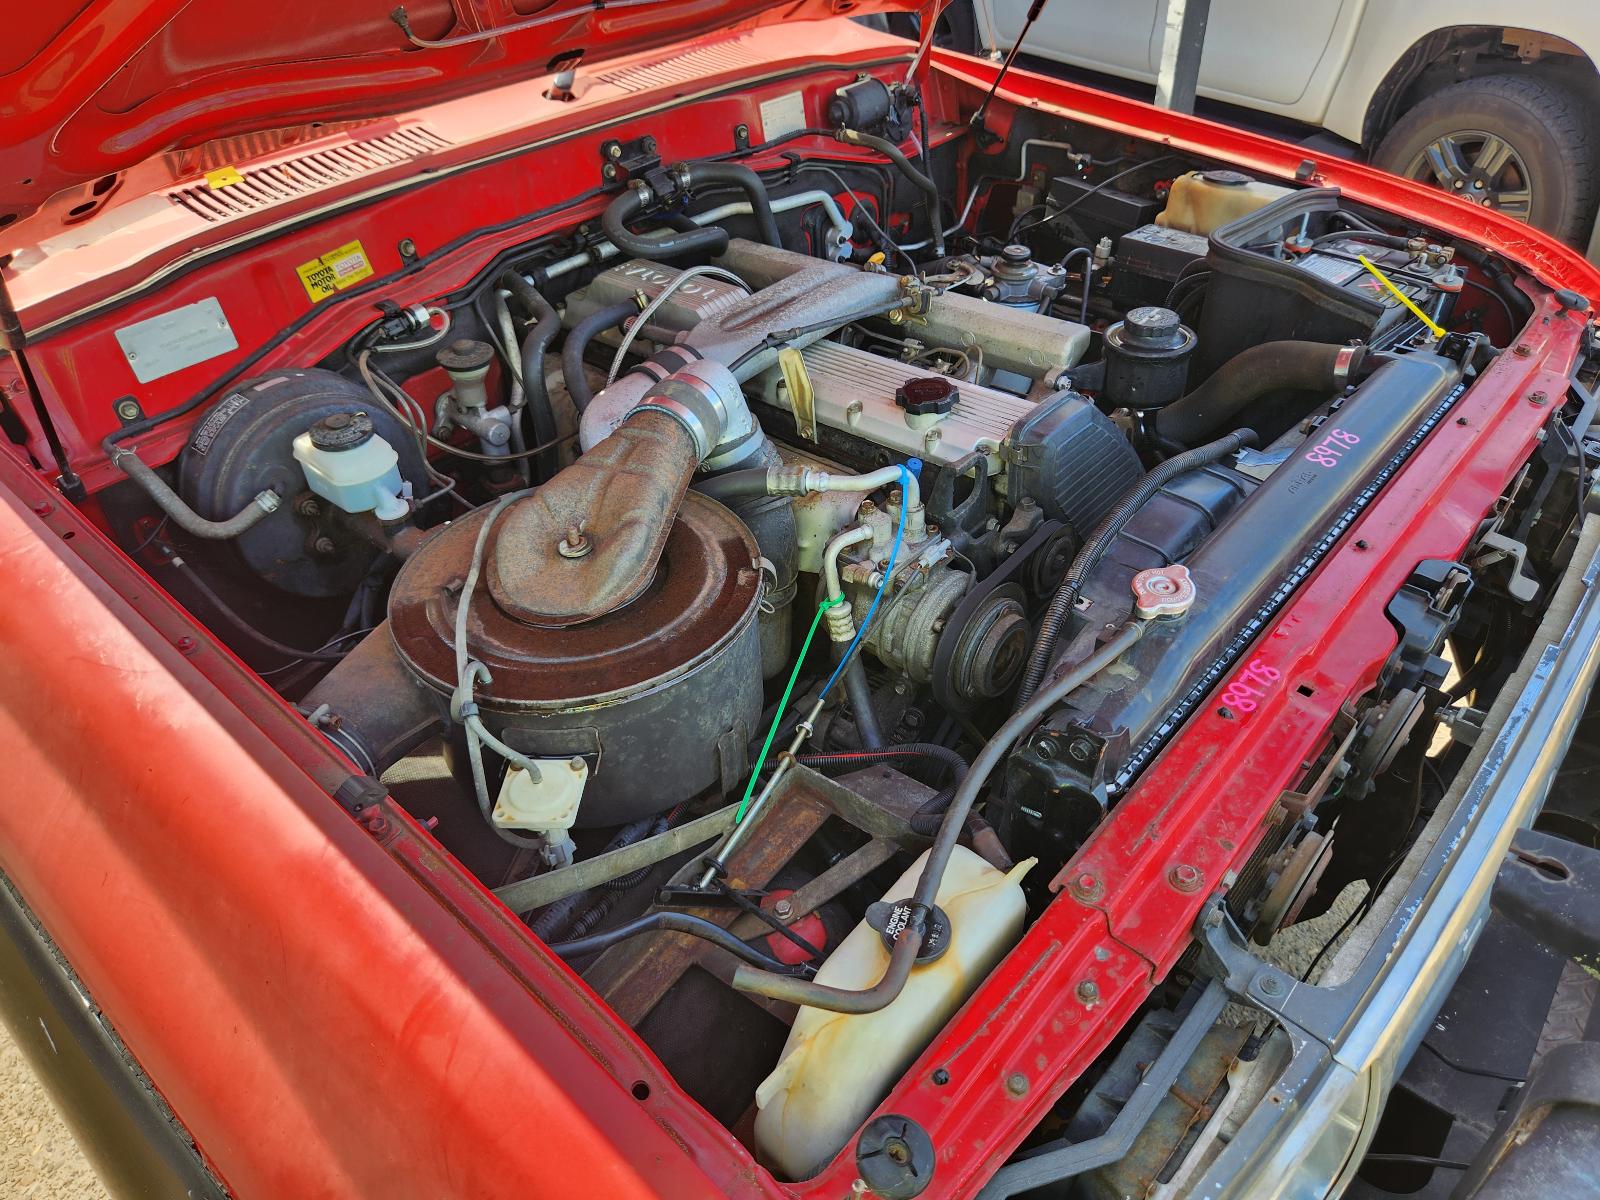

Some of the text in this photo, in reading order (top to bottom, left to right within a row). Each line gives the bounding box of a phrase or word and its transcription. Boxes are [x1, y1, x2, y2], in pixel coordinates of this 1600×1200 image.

[306, 266, 333, 282] TOYOTA
[311, 273, 336, 290] MOTOR
[322, 284, 333, 293] OIL
[1305, 428, 1360, 468] 8978
[1221, 658, 1281, 712] 8978
[885, 905, 903, 935] ENGINE
[892, 905, 912, 941] COOLANT
